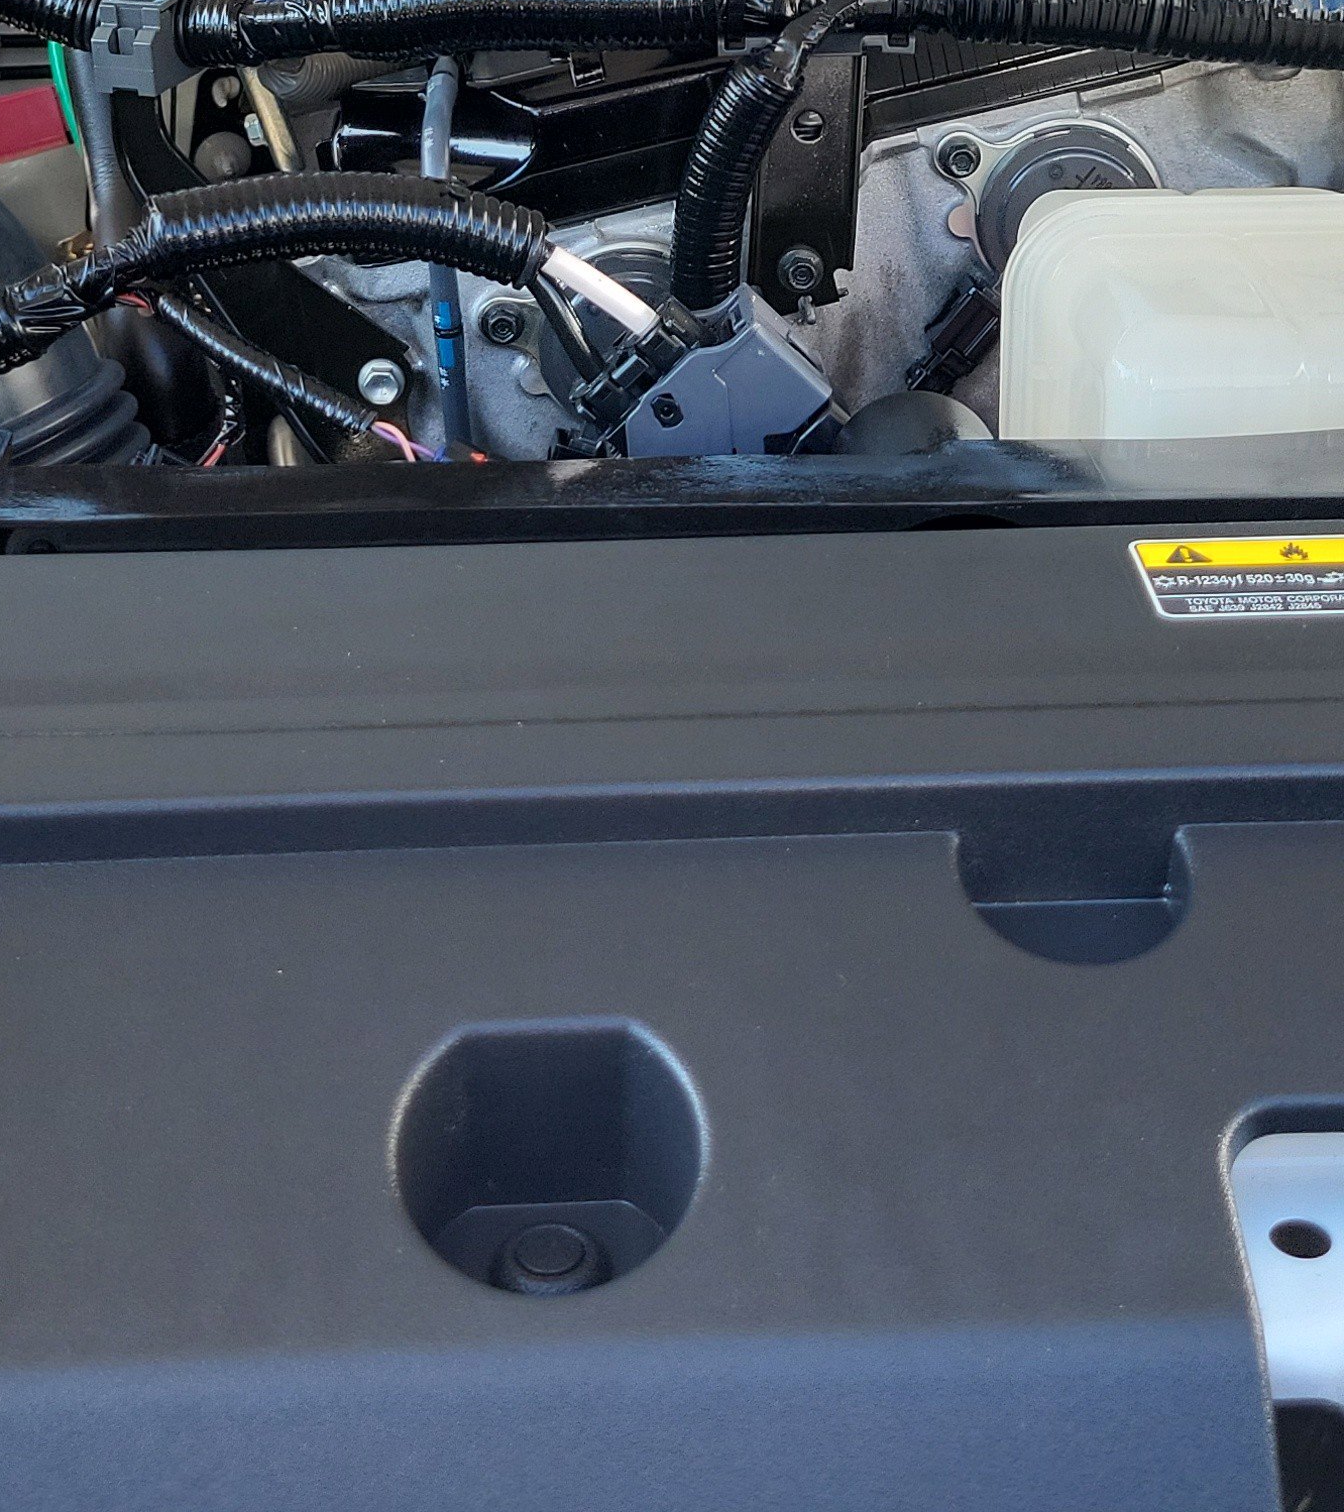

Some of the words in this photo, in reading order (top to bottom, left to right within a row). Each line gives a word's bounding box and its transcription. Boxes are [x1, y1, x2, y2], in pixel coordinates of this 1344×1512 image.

[1177, 574, 1243, 587] R-1234yf
[1246, 573, 1315, 585] 520±30g
[1184, 597, 1233, 605] TOYOTA
[1237, 596, 1282, 604] MOTOR
